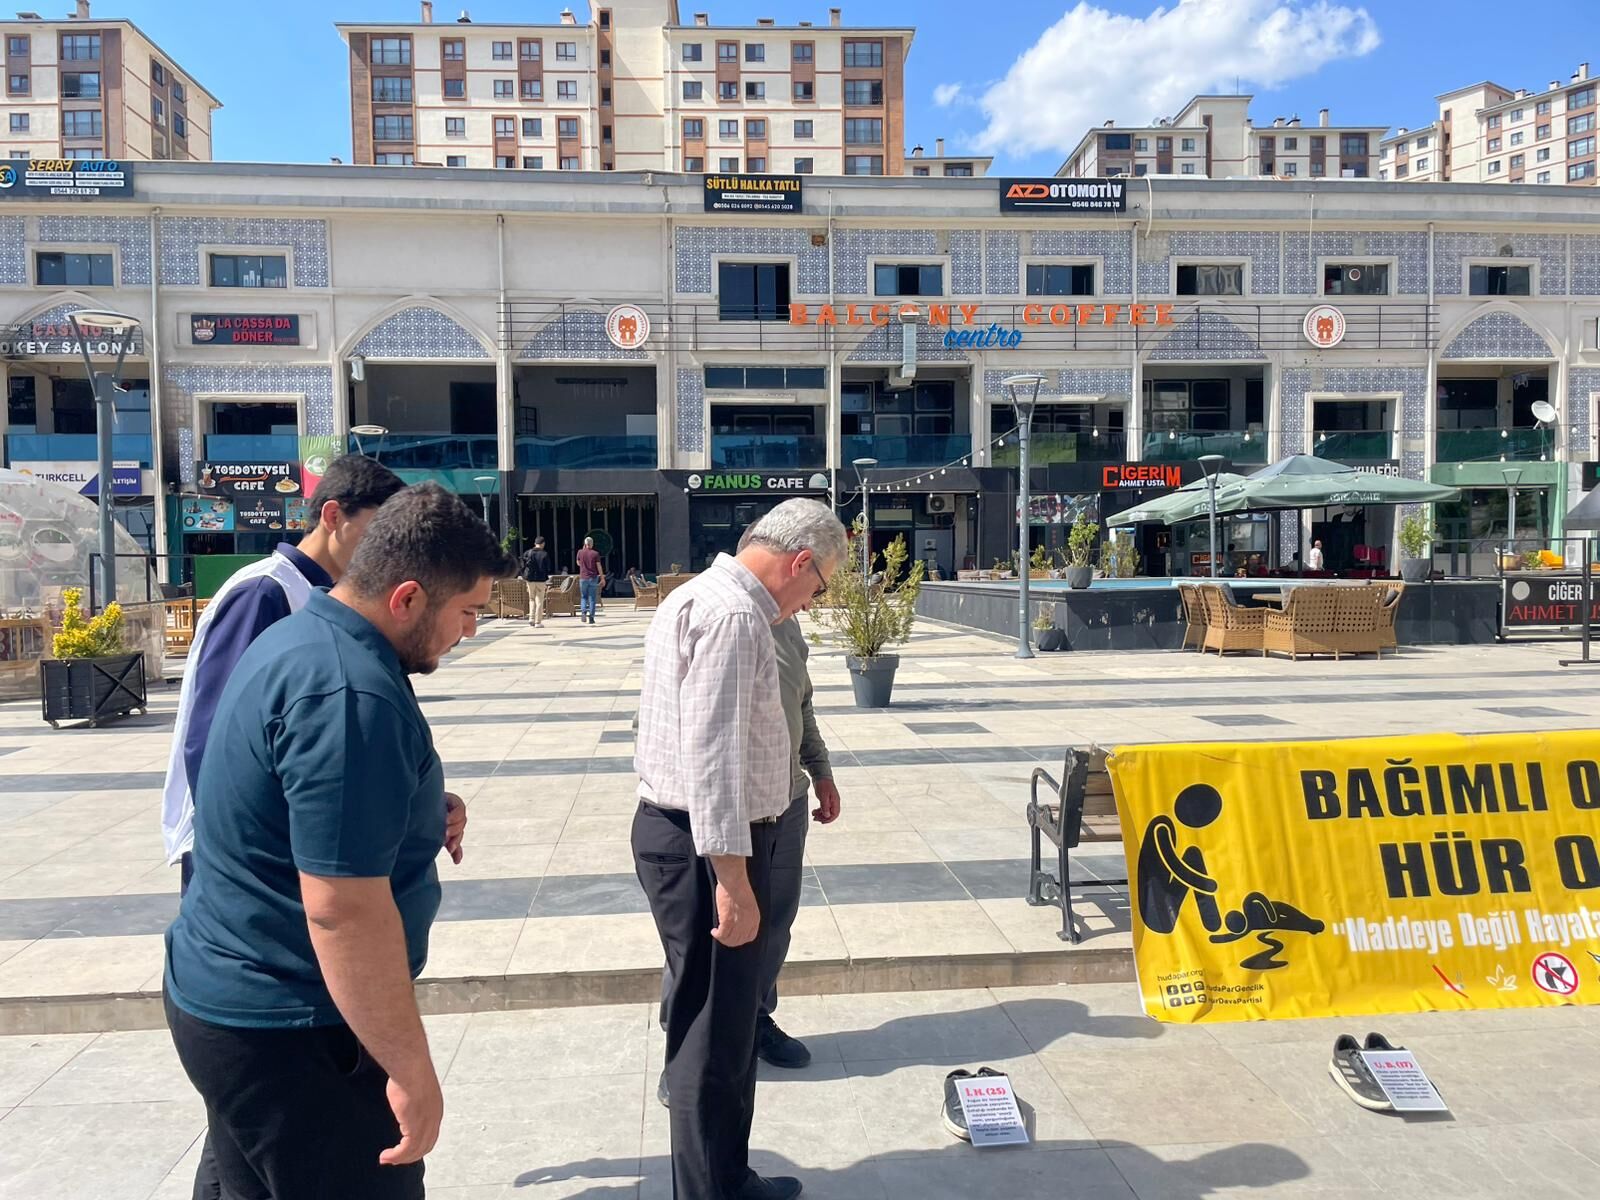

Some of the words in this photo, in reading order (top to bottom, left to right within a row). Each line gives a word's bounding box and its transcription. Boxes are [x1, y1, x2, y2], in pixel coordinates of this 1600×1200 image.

[28, 160, 73, 171] SERAY
[81, 161, 118, 171] AUTO
[706, 176, 738, 190] SÜTLÜ
[740, 179, 773, 191] HALKA
[773, 180, 800, 191] TATLI
[1049, 182, 1122, 198] OTOMOTİV
[1022, 303, 1175, 326] COFFEE
[216, 318, 232, 329] LA
[234, 318, 273, 329] CASSA
[232, 329, 273, 342] DÖNER
[943, 322, 1023, 350] centro
[233, 480, 265, 491] CAFE
[704, 474, 762, 489] FANUS
[767, 477, 804, 489] CAFE
[1508, 604, 1577, 620] AHMET
[1300, 757, 1548, 820] BAĞIMLI
[1379, 831, 1532, 899] HÜR
[1332, 915, 1454, 955] "Maddeye
[1458, 911, 1521, 951] Değil
[1157, 969, 1204, 982] hudapar.org
